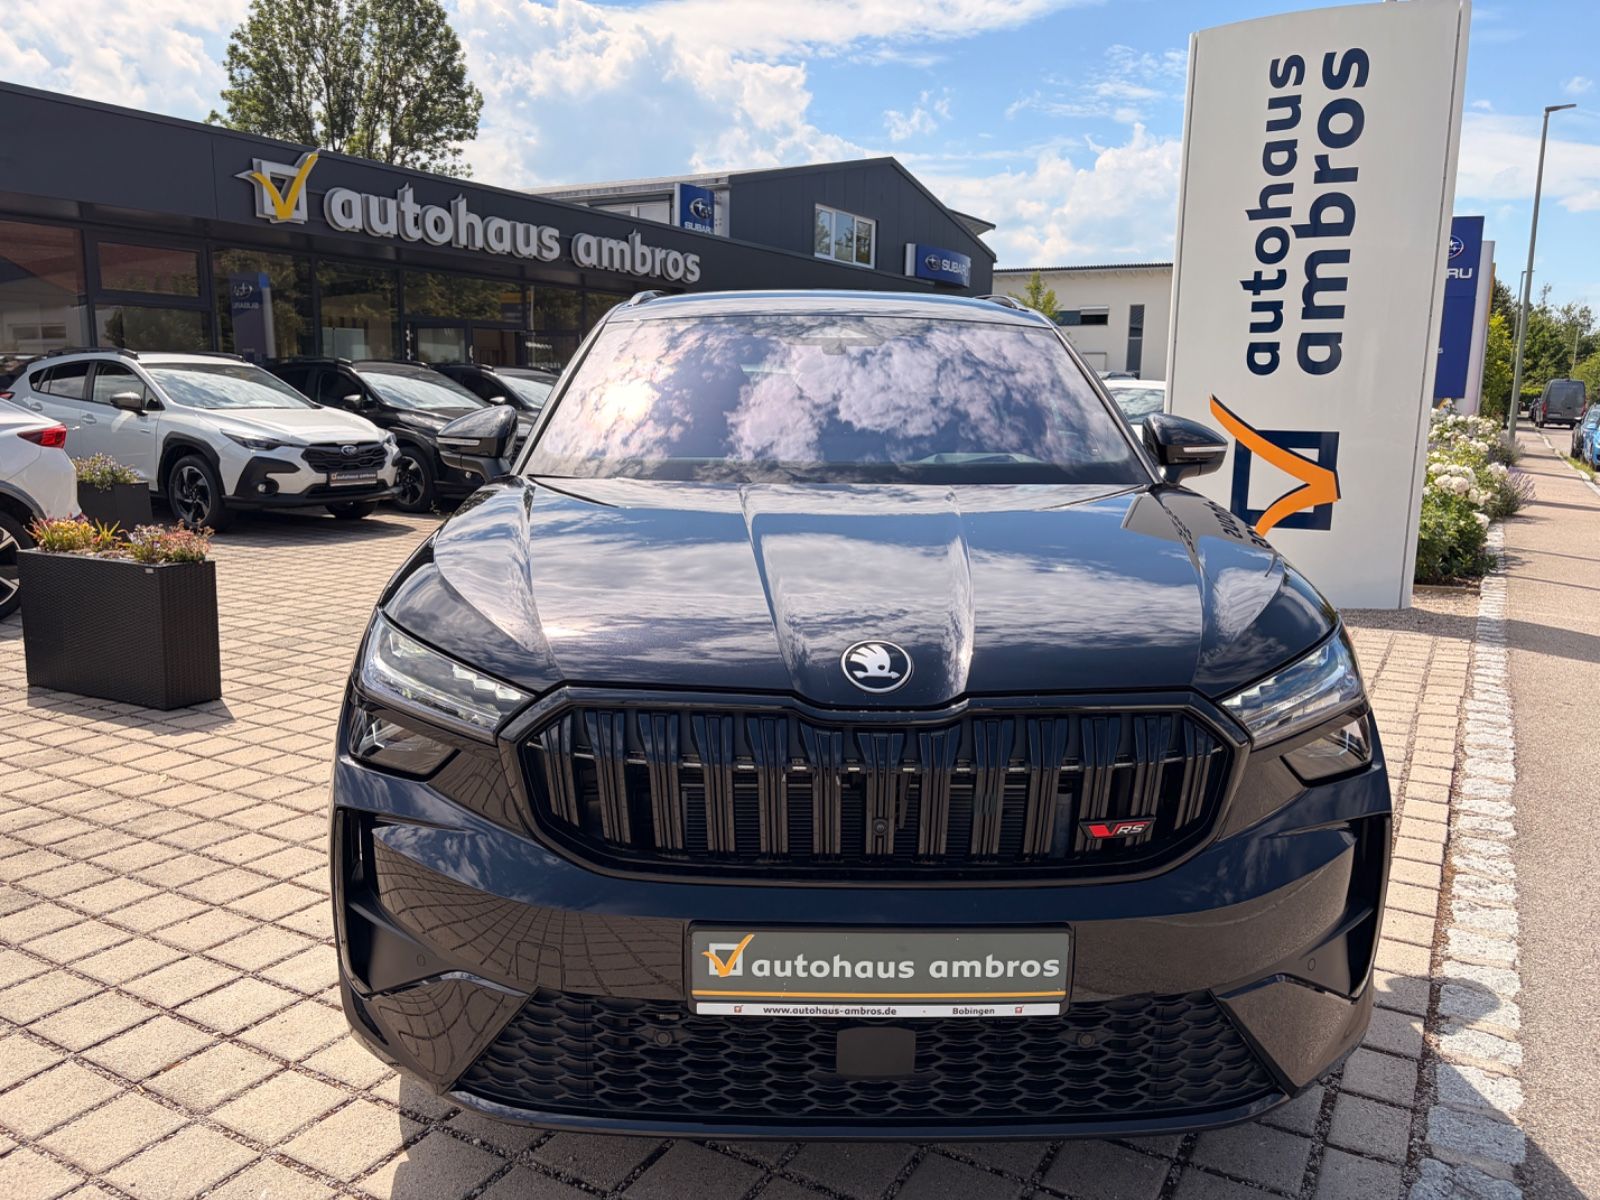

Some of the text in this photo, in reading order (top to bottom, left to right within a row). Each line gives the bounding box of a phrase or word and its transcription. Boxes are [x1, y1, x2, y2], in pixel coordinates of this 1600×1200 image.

[324, 182, 701, 283] autohaus ambros
[684, 221, 712, 235] SUBAR
[1240, 54, 1305, 376] autohaus
[1291, 48, 1370, 375] ambros
[751, 953, 1060, 979] autohaus ambros
[763, 1006, 995, 1015] www.autohaus-ambros.de Bobingen
